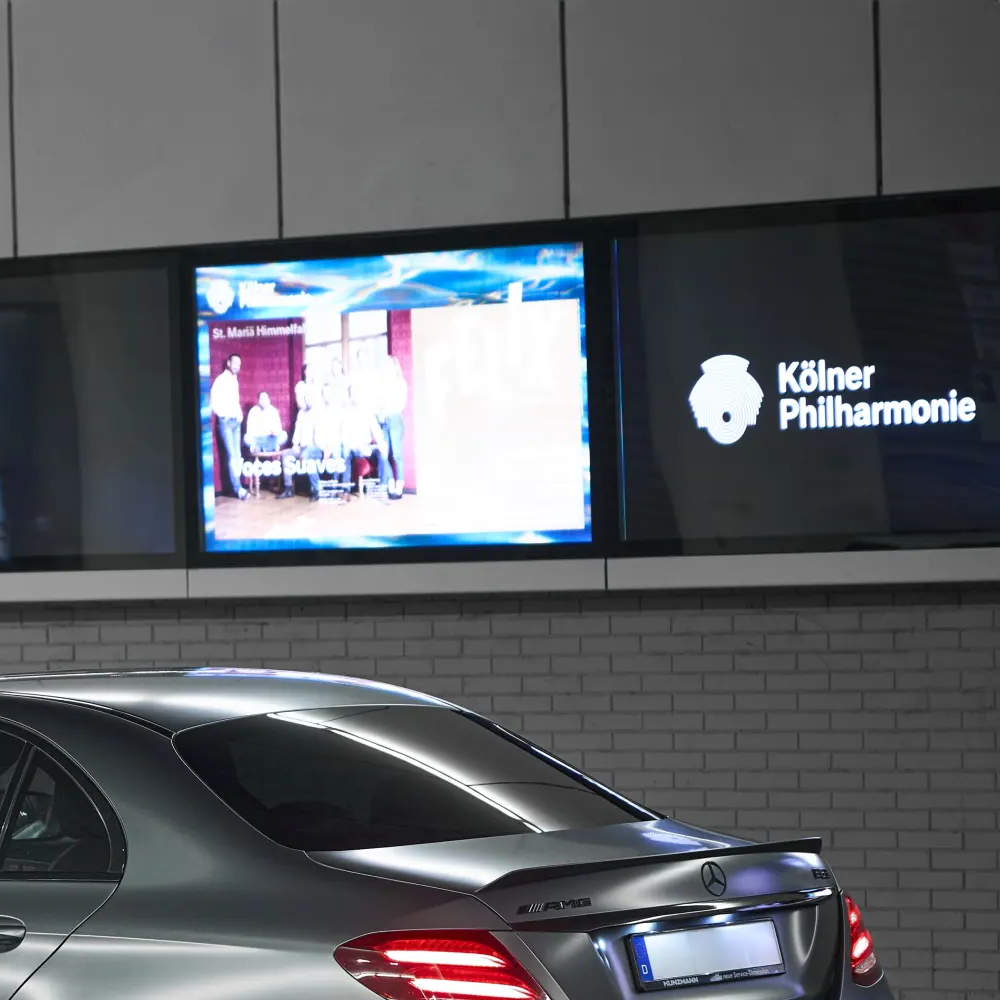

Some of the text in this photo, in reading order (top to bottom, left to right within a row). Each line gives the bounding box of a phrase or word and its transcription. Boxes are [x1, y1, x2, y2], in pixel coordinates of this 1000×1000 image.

[778, 358, 875, 394] Kölner
[779, 388, 977, 430] Philharmonie
[641, 964, 648, 974] D
[663, 976, 699, 987] KUNZMANN
